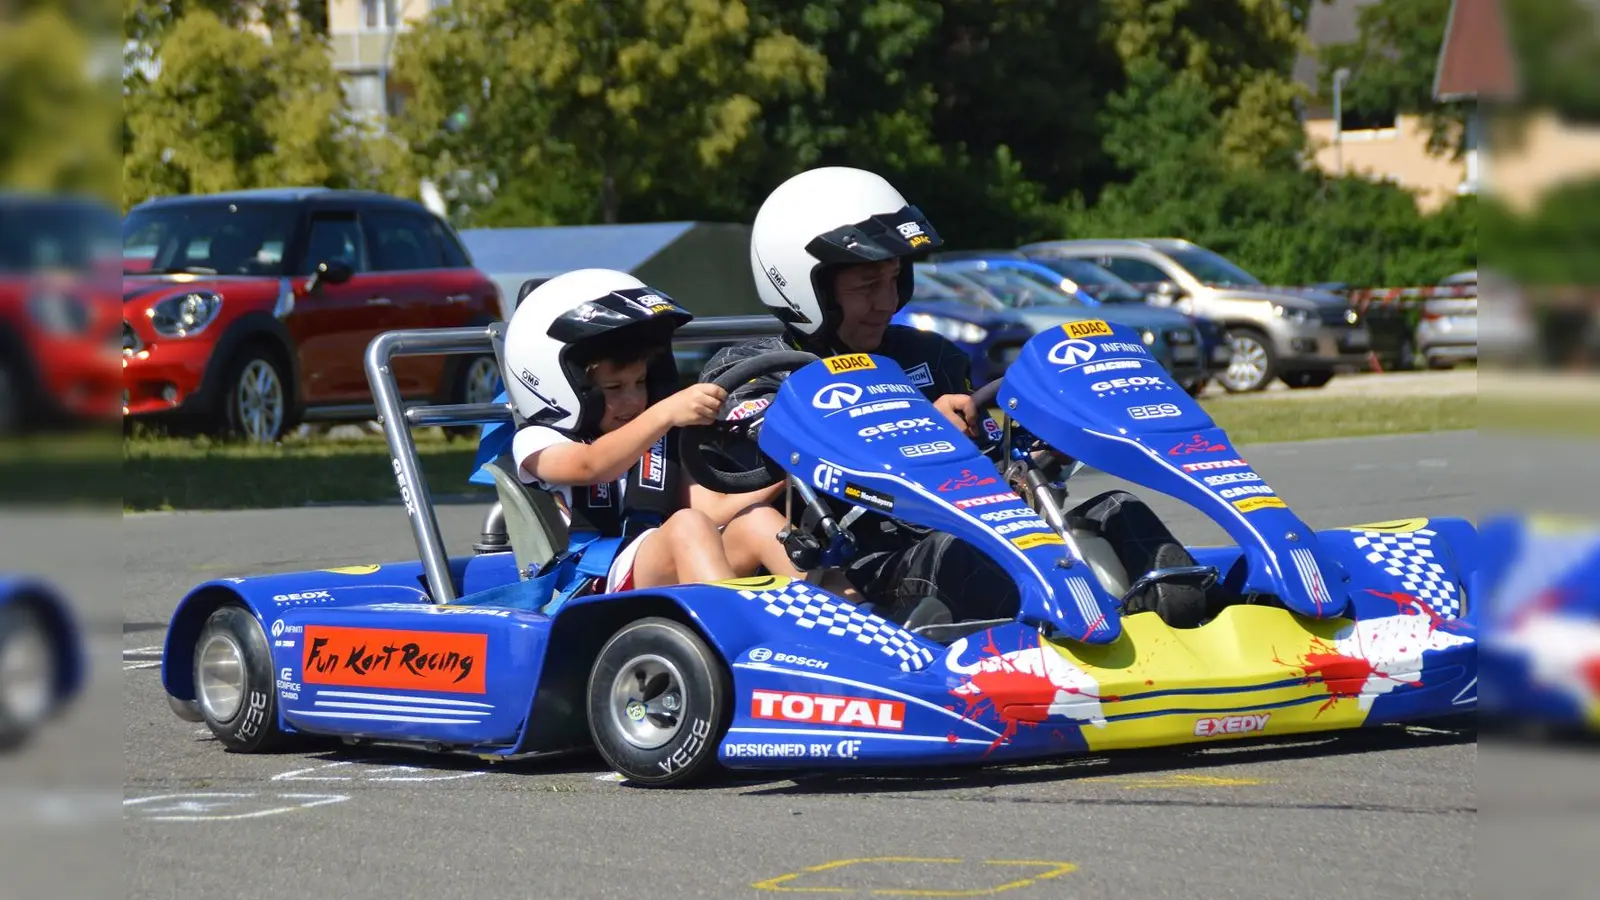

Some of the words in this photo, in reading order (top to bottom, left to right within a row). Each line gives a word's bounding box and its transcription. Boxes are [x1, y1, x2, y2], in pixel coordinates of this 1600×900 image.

[769, 267, 787, 287] OMP
[1070, 320, 1108, 337] ADAC
[1100, 342, 1147, 354] INFINITI
[831, 355, 870, 372] ADAC
[1083, 360, 1142, 375] RACING
[521, 369, 540, 387] OMP
[1090, 376, 1165, 391] GEOX
[867, 383, 916, 395] INFINITI
[849, 400, 911, 418] RACING
[1128, 404, 1181, 419] BBS
[858, 417, 937, 438] GEOX
[901, 441, 954, 457] BBS
[1183, 459, 1248, 472] TOTAL
[391, 458, 416, 517] GEOX
[1219, 485, 1274, 499] CASIO
[956, 491, 1022, 508] TOTAL
[995, 519, 1050, 534] CASIO
[273, 590, 332, 602] GEOX
[305, 637, 339, 675] Fun
[345, 641, 400, 676] Kart
[395, 642, 474, 684] Racing
[773, 652, 830, 670] BOSCH
[752, 691, 904, 728] TOTAL
[1194, 713, 1271, 737] EXEDY
[725, 743, 806, 757] DESIGNED
[810, 743, 833, 757] BY
